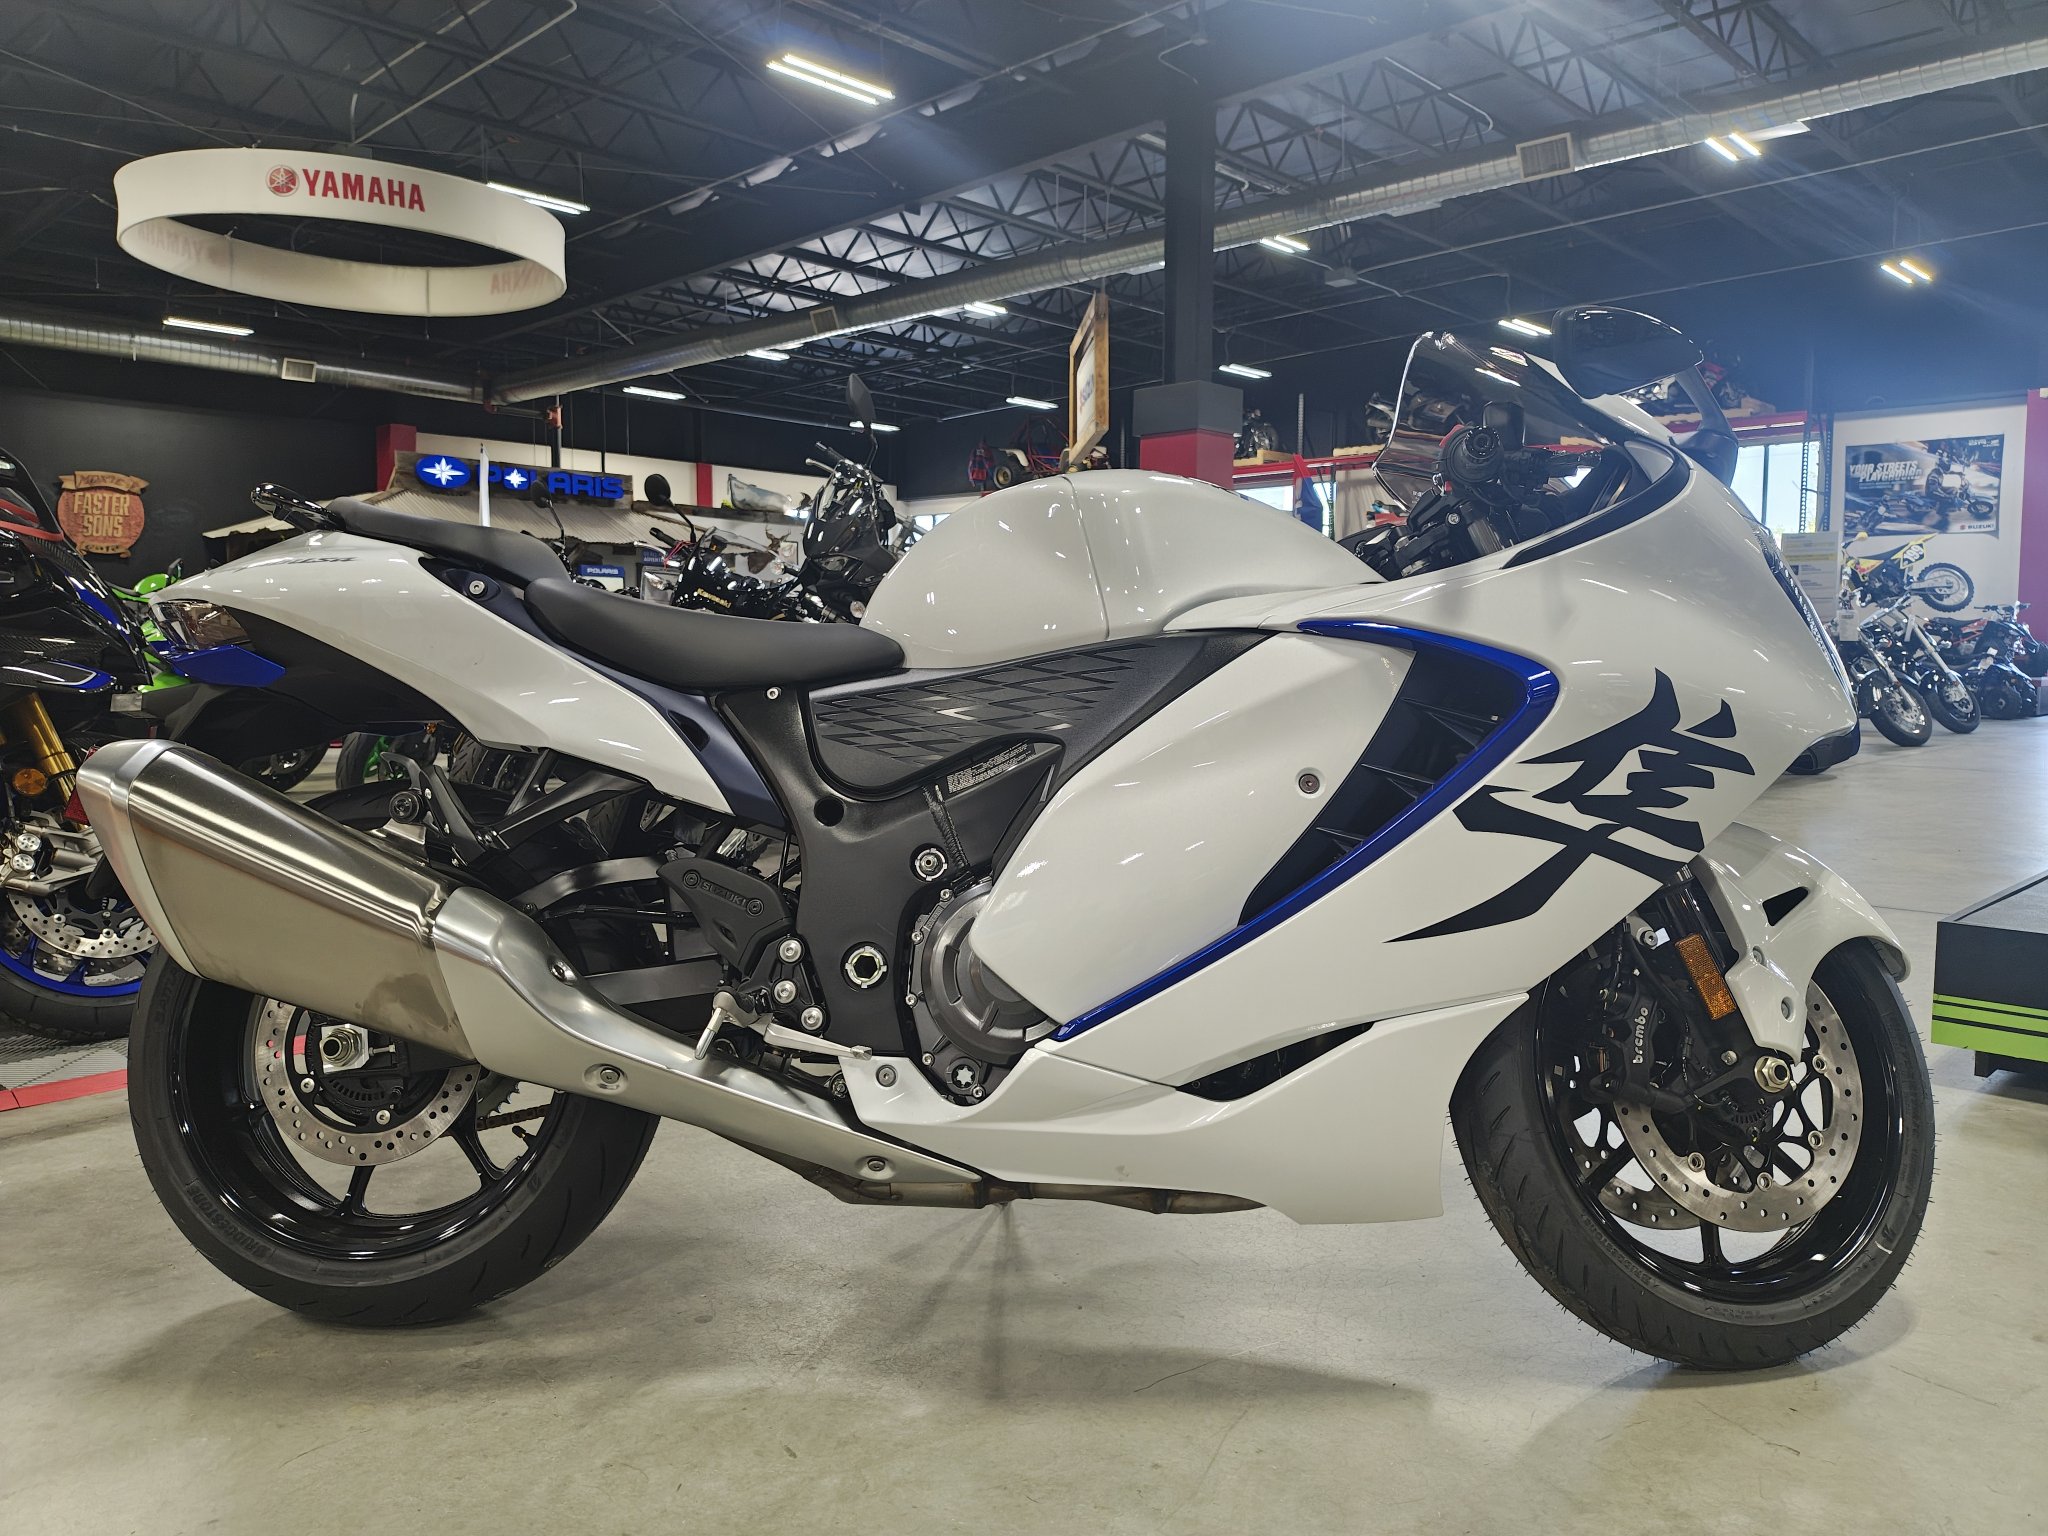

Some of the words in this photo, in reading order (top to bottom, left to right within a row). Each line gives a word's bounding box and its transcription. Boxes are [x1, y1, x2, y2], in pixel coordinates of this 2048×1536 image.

[302, 168, 425, 213] YAMAHA
[1850, 463, 1874, 476] YOUR
[1876, 461, 1918, 473] STREETS
[73, 491, 130, 516] FASTER
[83, 514, 123, 537] SONS
[587, 567, 619, 575] POLARIS
[701, 881, 747, 907] SUZUKI
[1632, 1007, 1649, 1064] brembo
